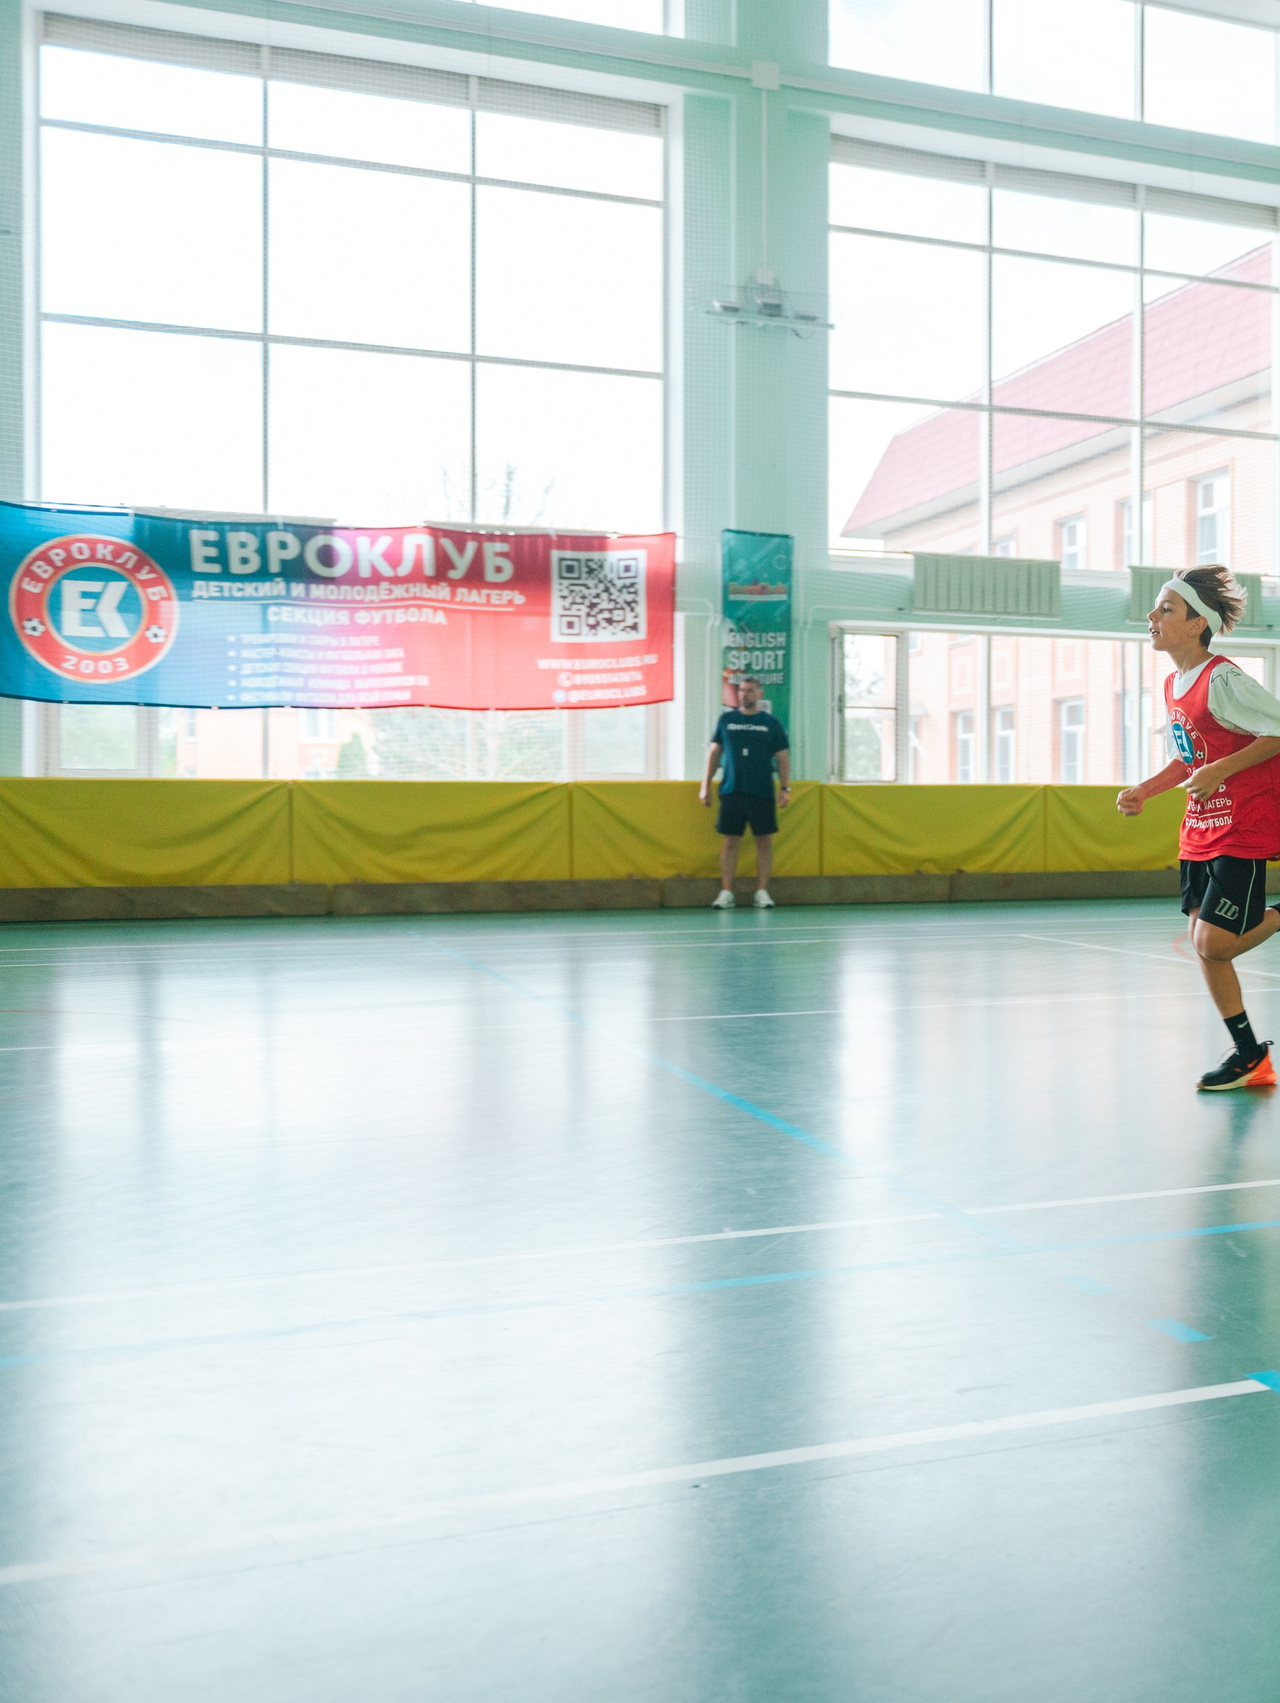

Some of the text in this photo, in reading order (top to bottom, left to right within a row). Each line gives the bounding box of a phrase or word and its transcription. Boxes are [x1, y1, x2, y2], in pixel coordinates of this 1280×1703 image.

[188, 529, 515, 583] ЕВРОКЛУБ
[20, 542, 170, 602] ЕВРОКЛУБ
[192, 577, 527, 605] ДЕТСКИЙ И МОЛОДЁЖНЫЙ ЛАГЕРЬ
[61, 579, 133, 638] ЕК
[266, 606, 449, 627] СЕКЦИЯ ФУТБОЛА
[61, 654, 130, 674] 2003
[728, 650, 786, 670] SPORT
